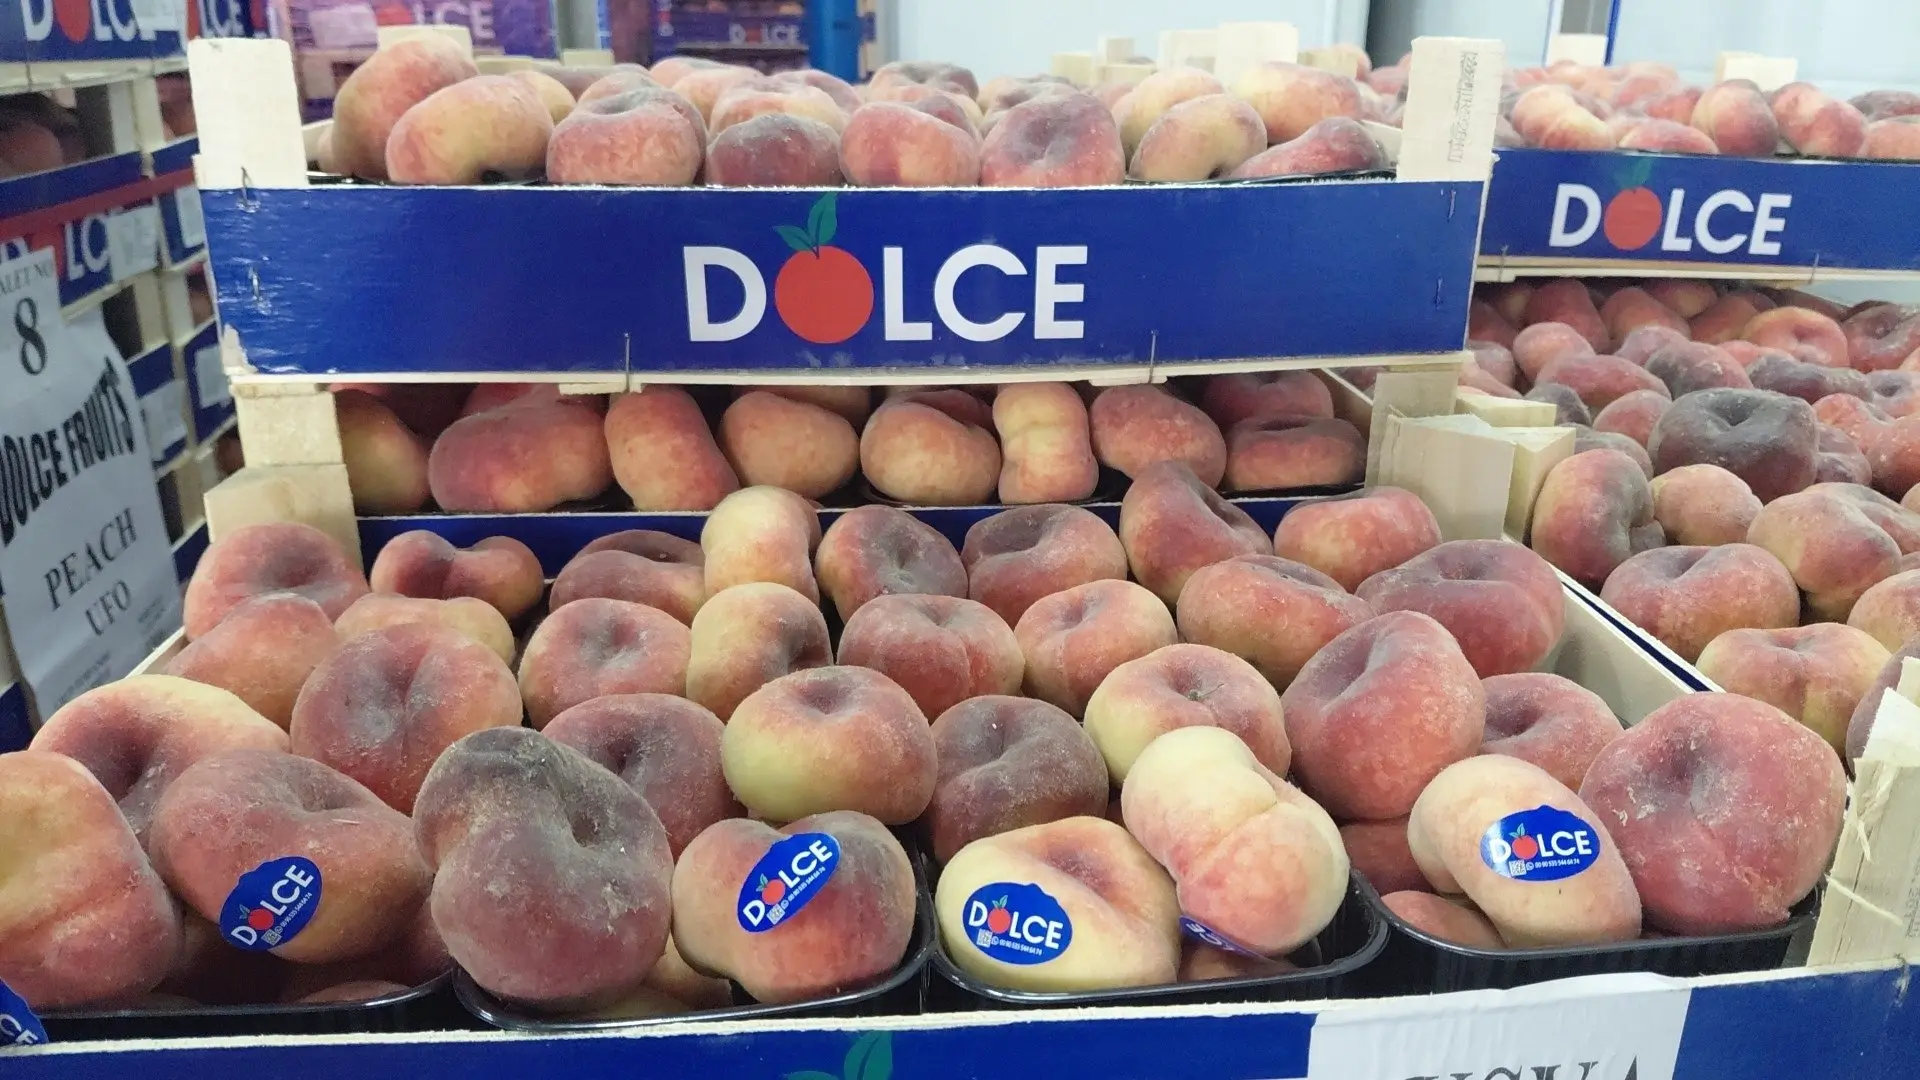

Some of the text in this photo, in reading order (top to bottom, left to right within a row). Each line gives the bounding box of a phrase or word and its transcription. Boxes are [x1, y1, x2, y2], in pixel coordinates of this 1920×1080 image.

[20, 0, 157, 42] DOLC
[1548, 183, 1793, 255] DOLCE
[683, 244, 1089, 344] DOLCE
[15, 297, 47, 376] 8
[62, 356, 136, 476] FRUITS
[43, 507, 139, 612] PEACH
[85, 579, 131, 637] UFO
[743, 840, 833, 927] DOLCE
[1489, 830, 1593, 864] DOLCE
[230, 864, 315, 946] DOLCE
[968, 900, 1064, 949] DOLCE
